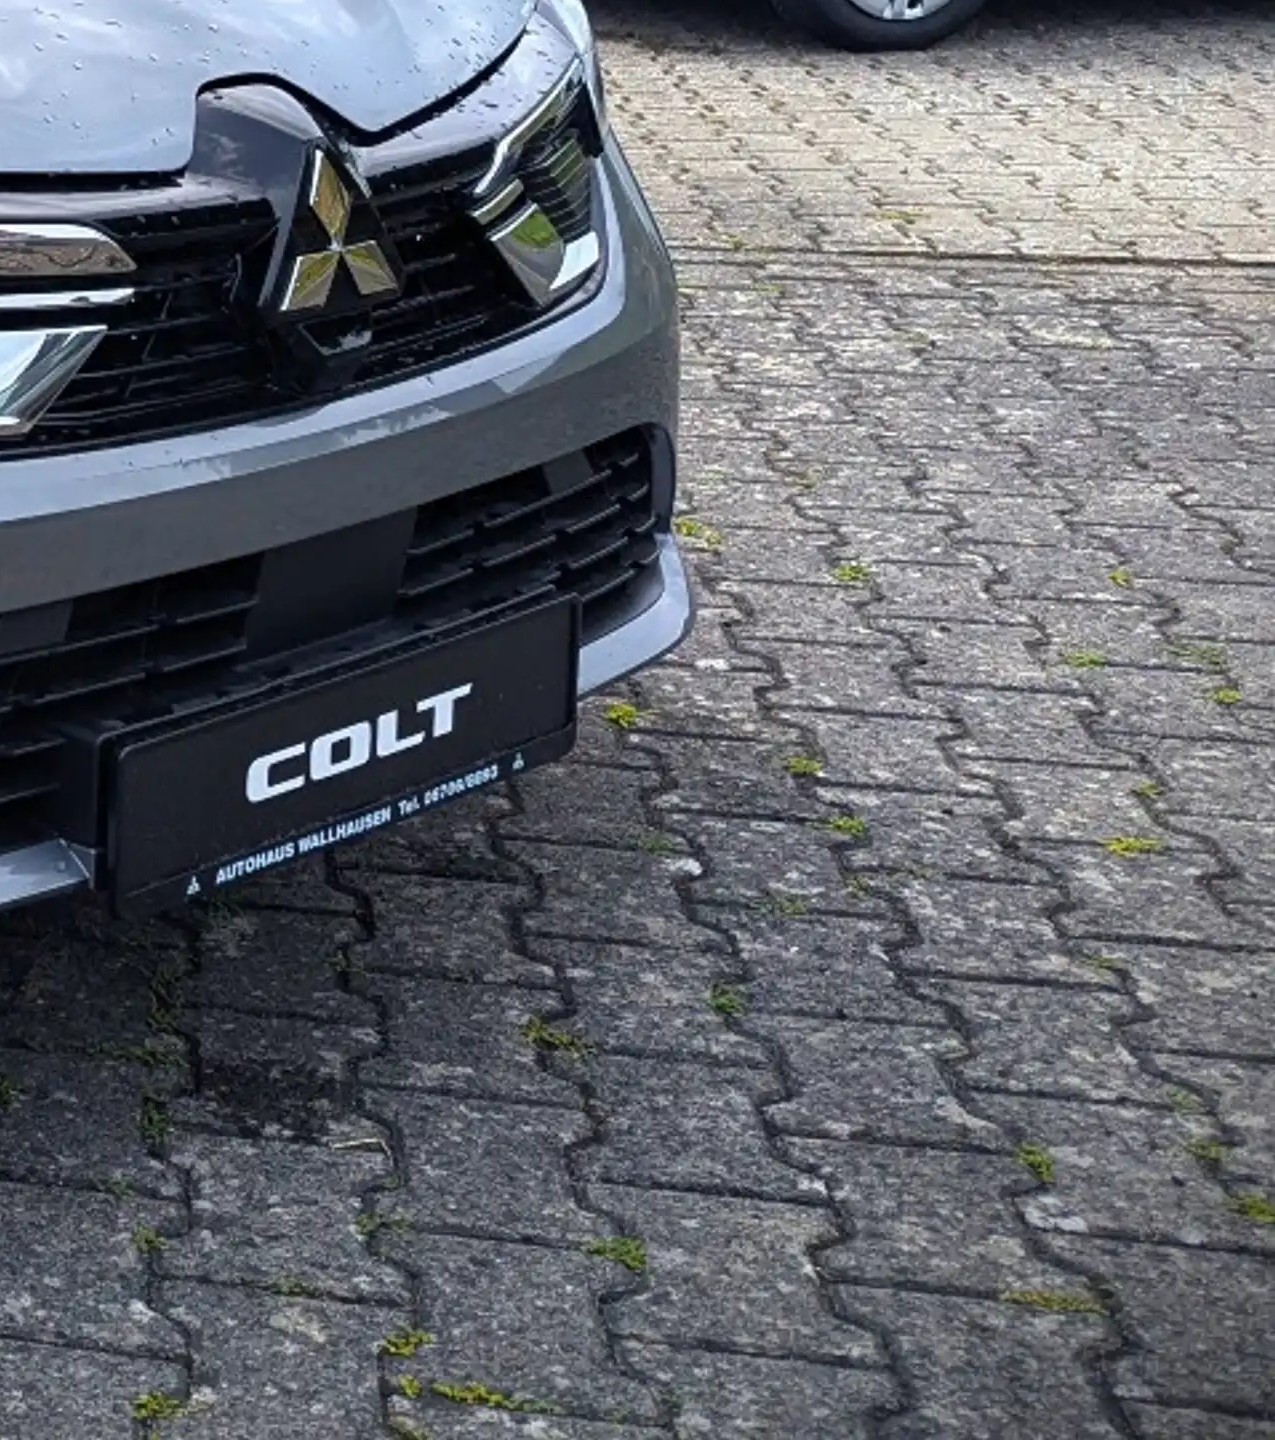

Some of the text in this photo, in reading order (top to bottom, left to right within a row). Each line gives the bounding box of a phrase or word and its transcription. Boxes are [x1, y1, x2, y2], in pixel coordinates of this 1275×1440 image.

[246, 682, 473, 803] COLT
[215, 842, 295, 885] AUTOHAUS
[297, 805, 392, 854] WALLHAUSEN
[397, 794, 420, 817] Tel.
